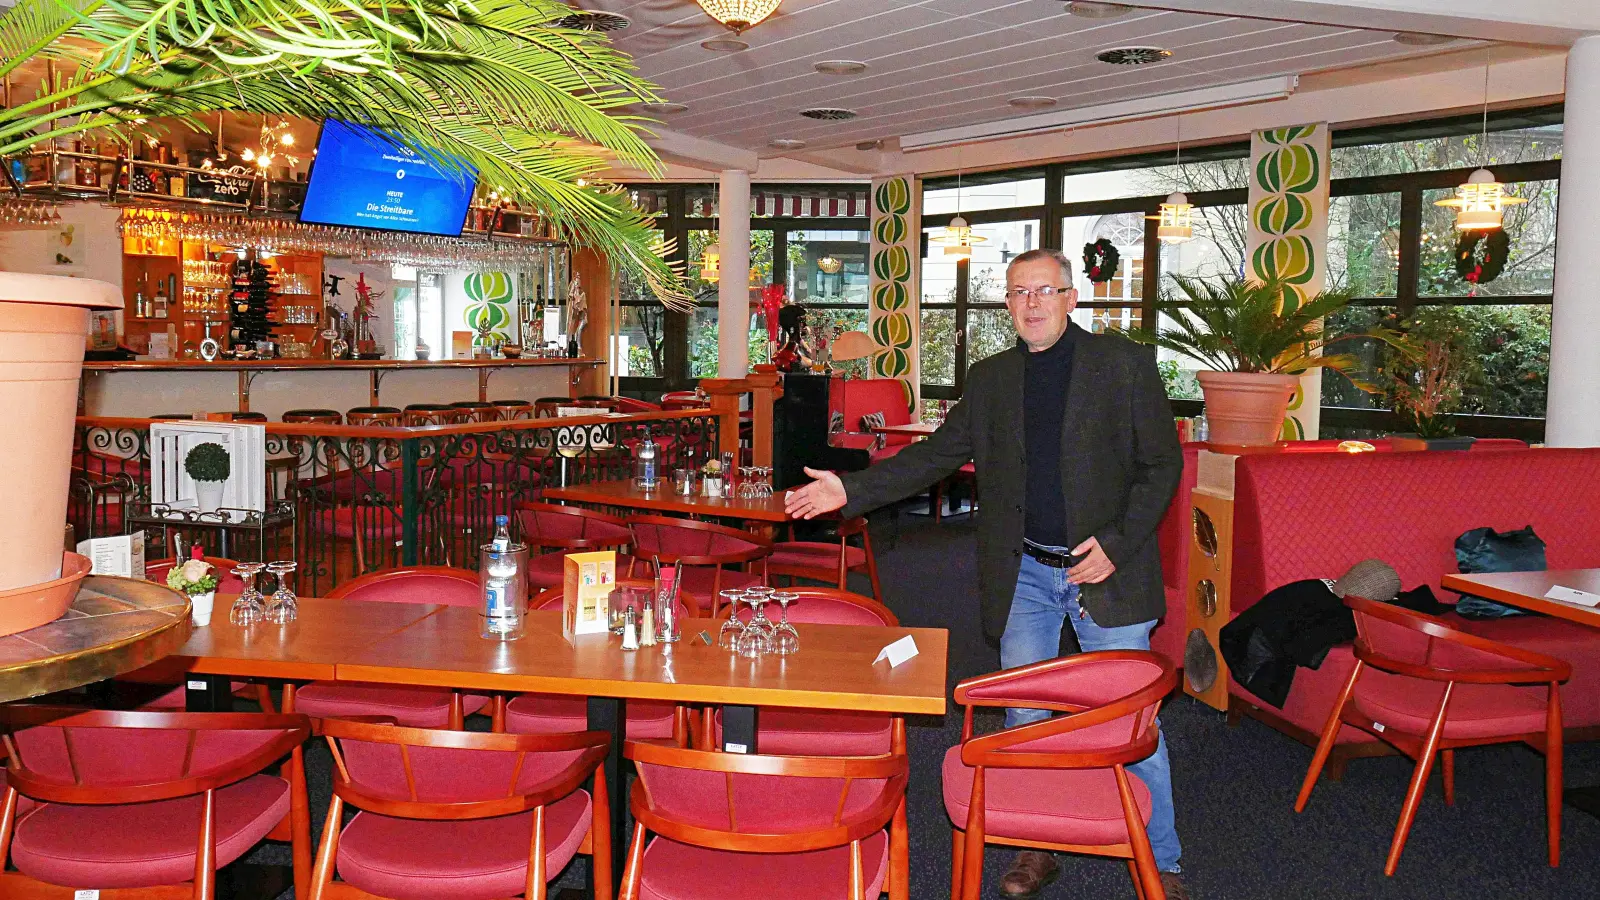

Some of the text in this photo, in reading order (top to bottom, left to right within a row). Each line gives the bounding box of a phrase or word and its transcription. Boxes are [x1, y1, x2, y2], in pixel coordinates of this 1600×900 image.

[214, 184, 240, 196] zero
[386, 190, 403, 198] HEUTE
[366, 203, 414, 215] Die Streitbare
